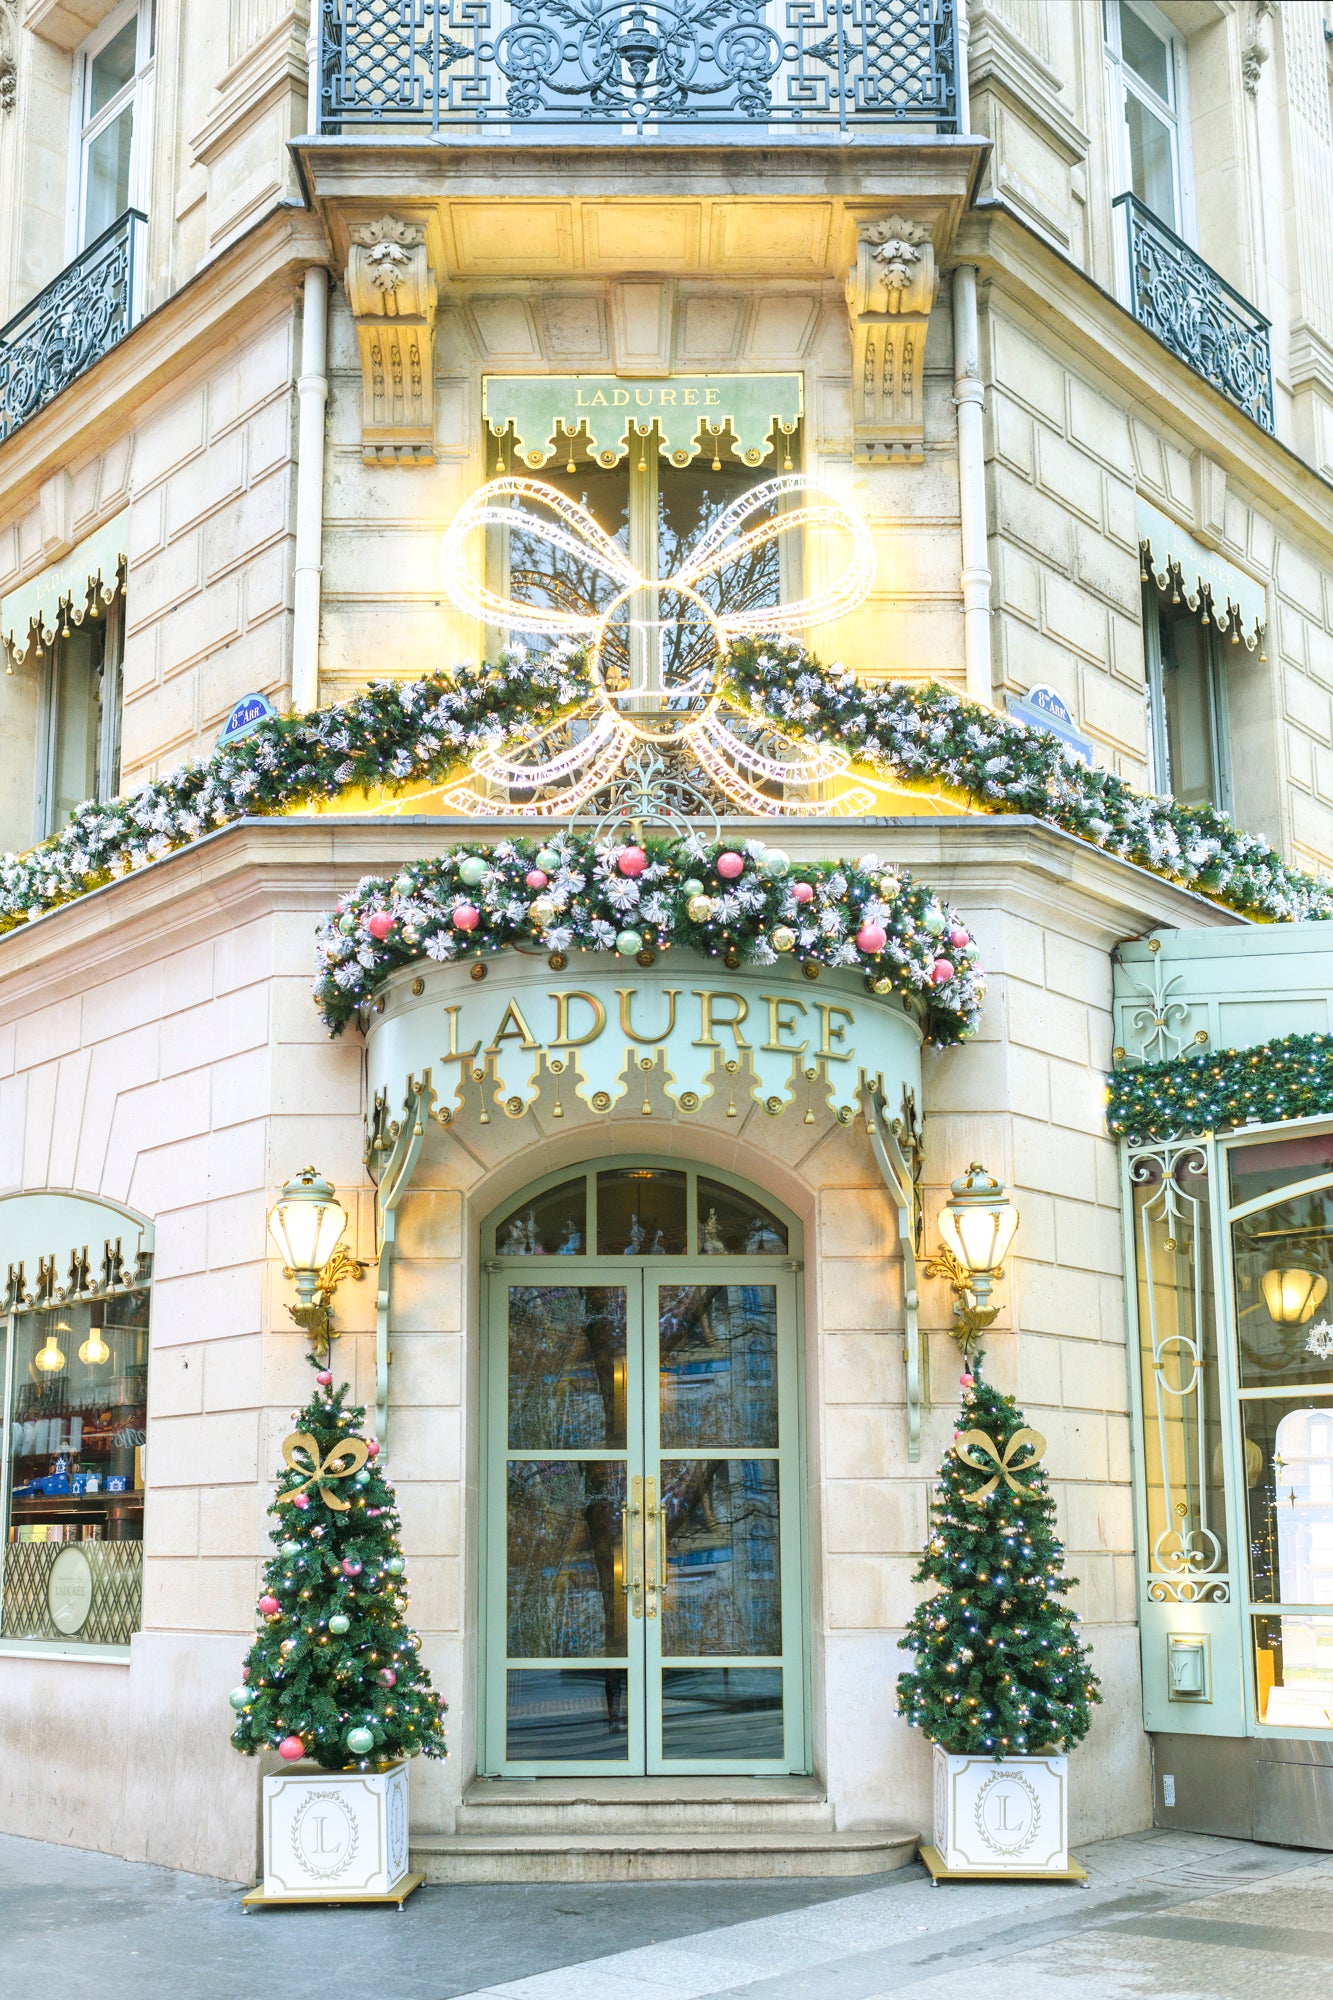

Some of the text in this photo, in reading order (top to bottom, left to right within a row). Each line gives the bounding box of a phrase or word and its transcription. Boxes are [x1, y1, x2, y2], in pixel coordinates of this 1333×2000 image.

[575, 388, 721, 406] LADUREE
[440, 988, 856, 1062] LADUREE
[995, 1795, 1024, 1831] L
[312, 1816, 341, 1854] L
